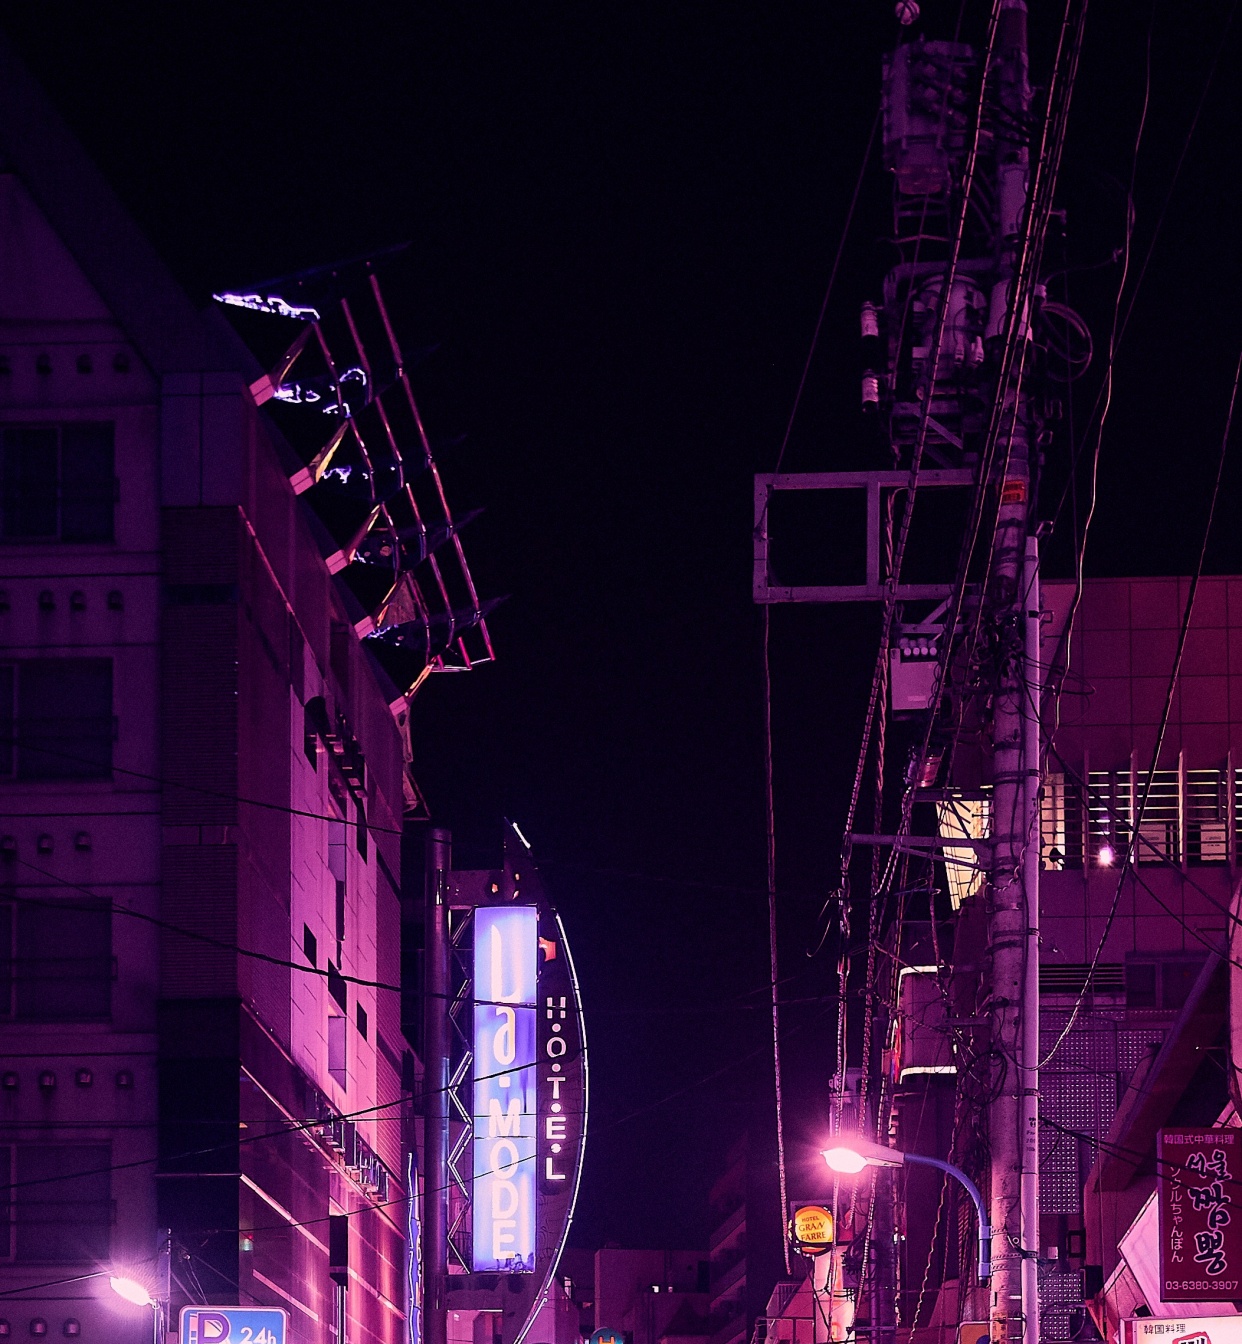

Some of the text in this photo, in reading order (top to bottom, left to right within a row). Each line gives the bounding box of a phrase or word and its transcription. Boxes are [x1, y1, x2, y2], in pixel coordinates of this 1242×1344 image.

[1163, 1134, 1235, 1145] 韓国式中華料理
[1165, 1280, 1239, 1290] 03-6380-3907
